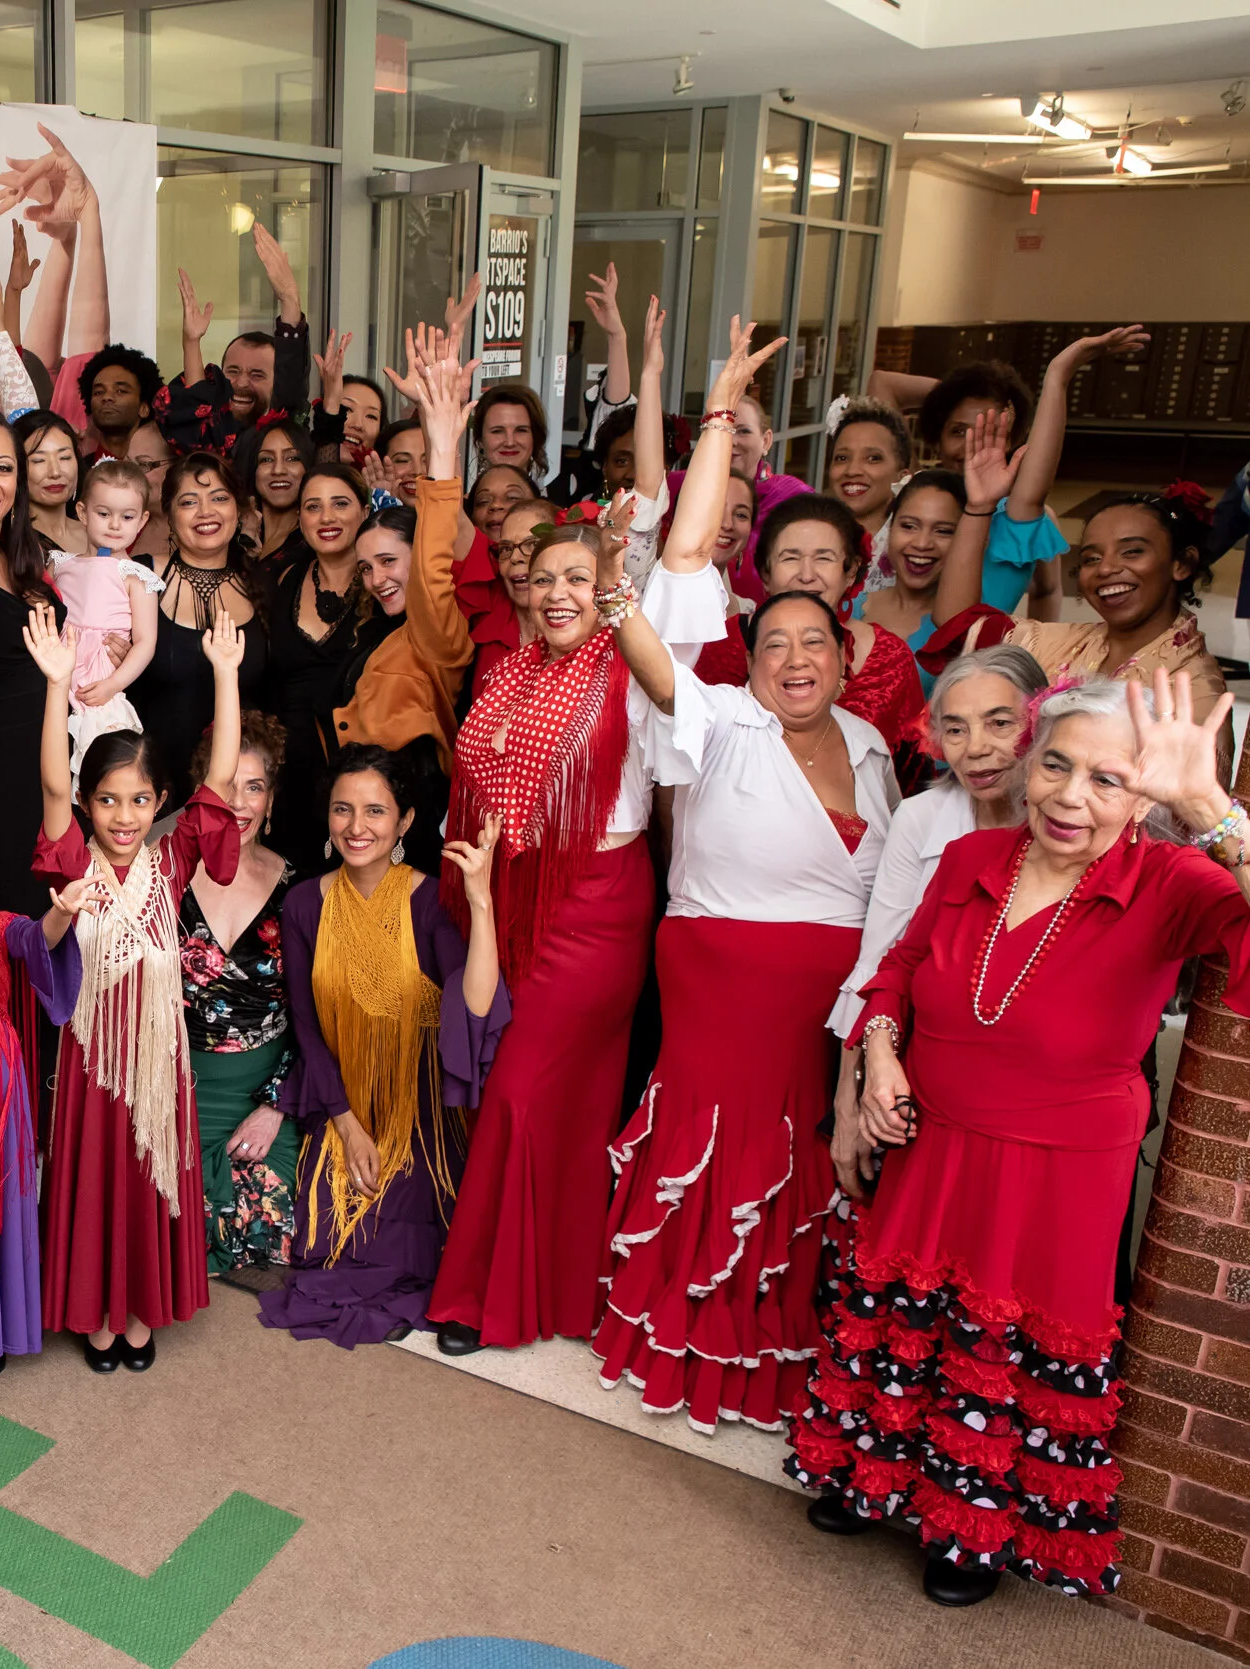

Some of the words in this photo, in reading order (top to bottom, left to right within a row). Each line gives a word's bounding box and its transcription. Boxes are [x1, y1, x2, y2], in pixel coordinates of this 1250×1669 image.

[490, 229, 528, 254] BARRIO'S
[485, 291, 525, 340] S109
[501, 364, 510, 376] LEFT
